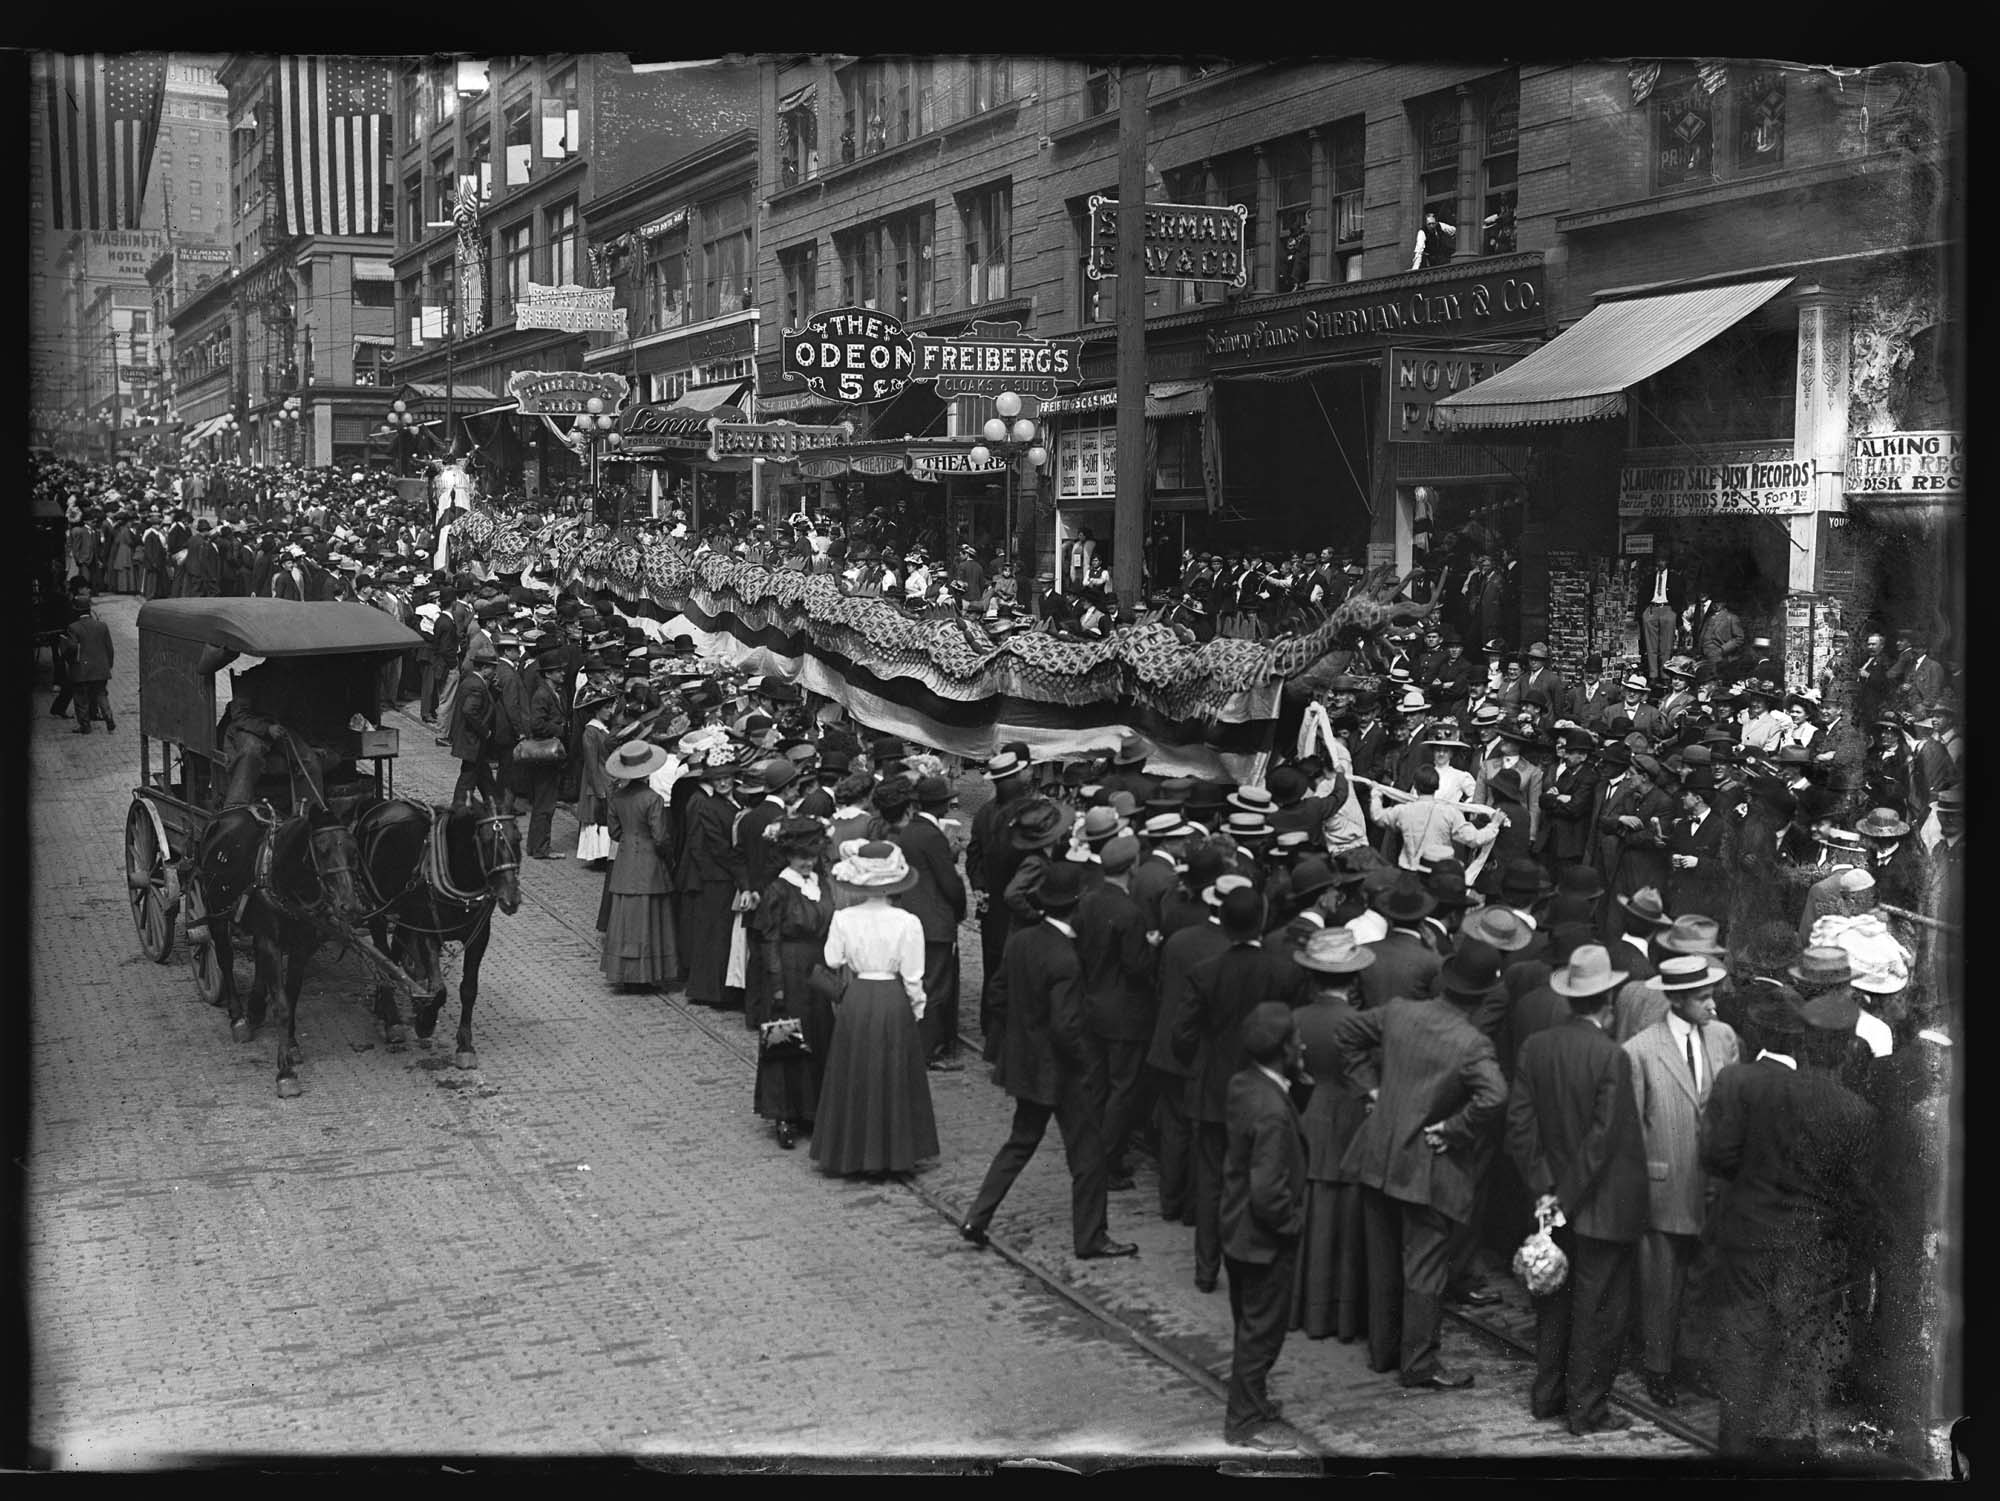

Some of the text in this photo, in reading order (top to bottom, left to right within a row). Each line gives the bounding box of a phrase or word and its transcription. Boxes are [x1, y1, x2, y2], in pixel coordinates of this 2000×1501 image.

[1099, 211, 1238, 243] SERMAN
[108, 251, 146, 262] HOTEL
[1175, 246, 1194, 273] &
[521, 310, 622, 330] DENTISTS
[1253, 320, 1300, 349] Pianos
[1411, 292, 1464, 325] CLAY
[1472, 283, 1491, 317] &
[830, 315, 883, 340] THE
[795, 343, 913, 369] ODEON
[924, 342, 1070, 374] FREIBERG'S
[944, 378, 992, 392] CLOAKS
[1013, 379, 1050, 392] SUITS
[627, 437, 643, 446] FOR
[648, 438, 677, 447] GLOVES
[718, 429, 787, 454] RAVEN
[1854, 436, 1940, 457] TALKING
[860, 456, 899, 473] THEATRE
[1865, 456, 1912, 477] HALF
[1622, 462, 1810, 492] SLAUGHTER SALE DISK RECORDS
[1863, 476, 1902, 491] DISK
[1669, 492, 1718, 508] RECORDS
[1750, 490, 1762, 507] 5
